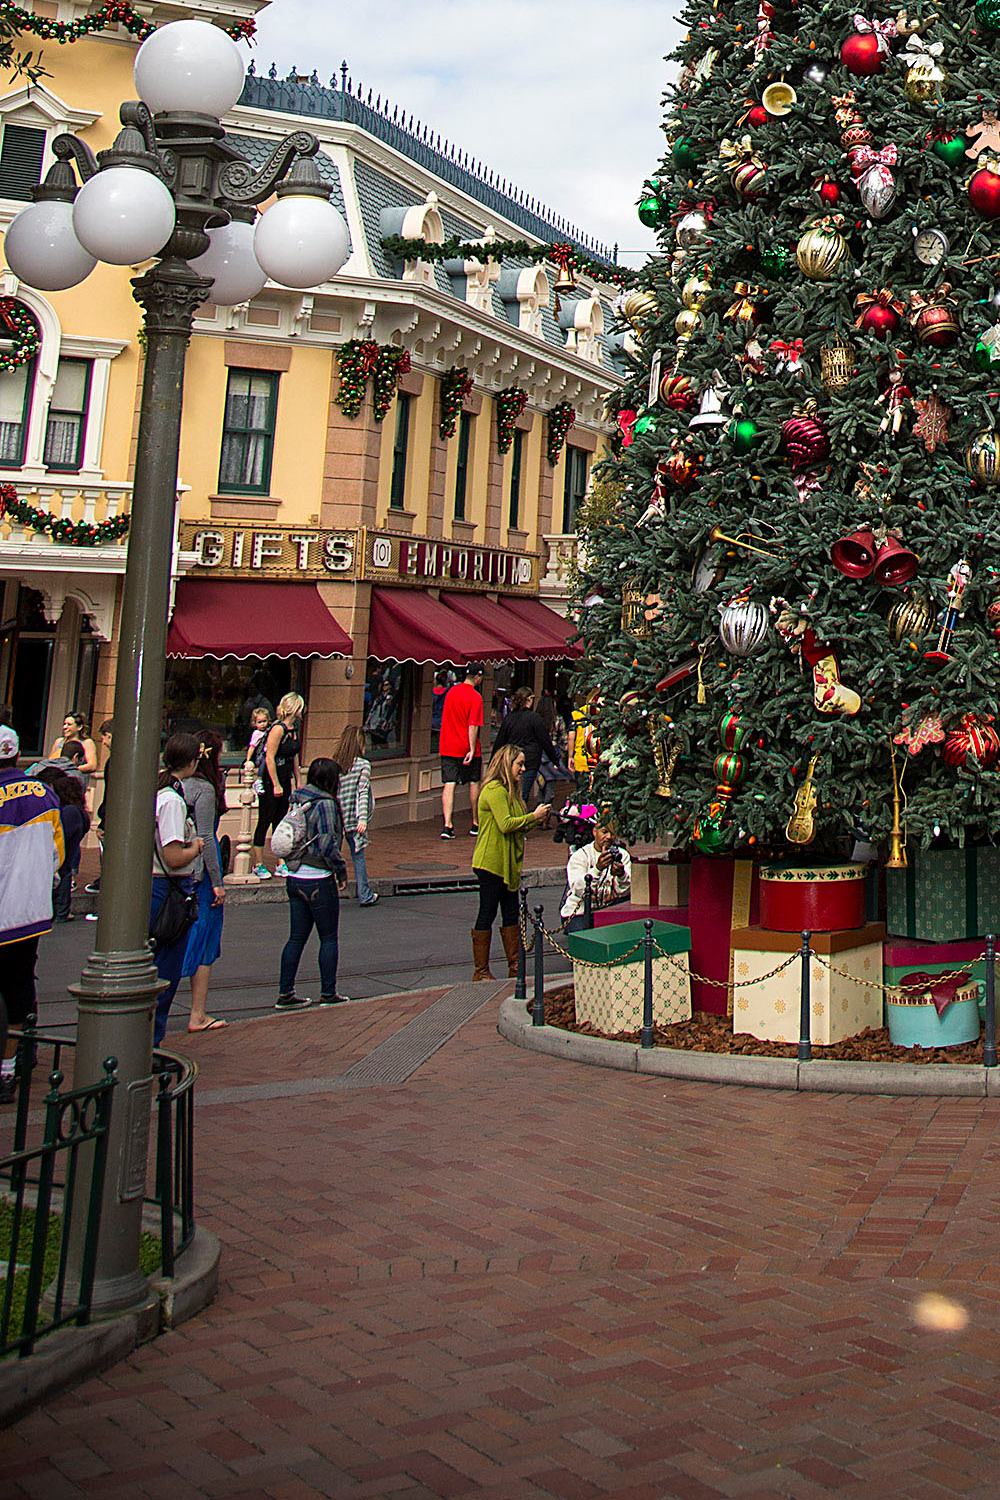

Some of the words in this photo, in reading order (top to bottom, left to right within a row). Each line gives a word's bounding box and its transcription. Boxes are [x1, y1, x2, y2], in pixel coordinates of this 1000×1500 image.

[194, 529, 354, 571] GIFTS
[375, 543, 390, 562] 101
[403, 540, 521, 586] EMPORIUM
[0, 781, 46, 807] AKERS
